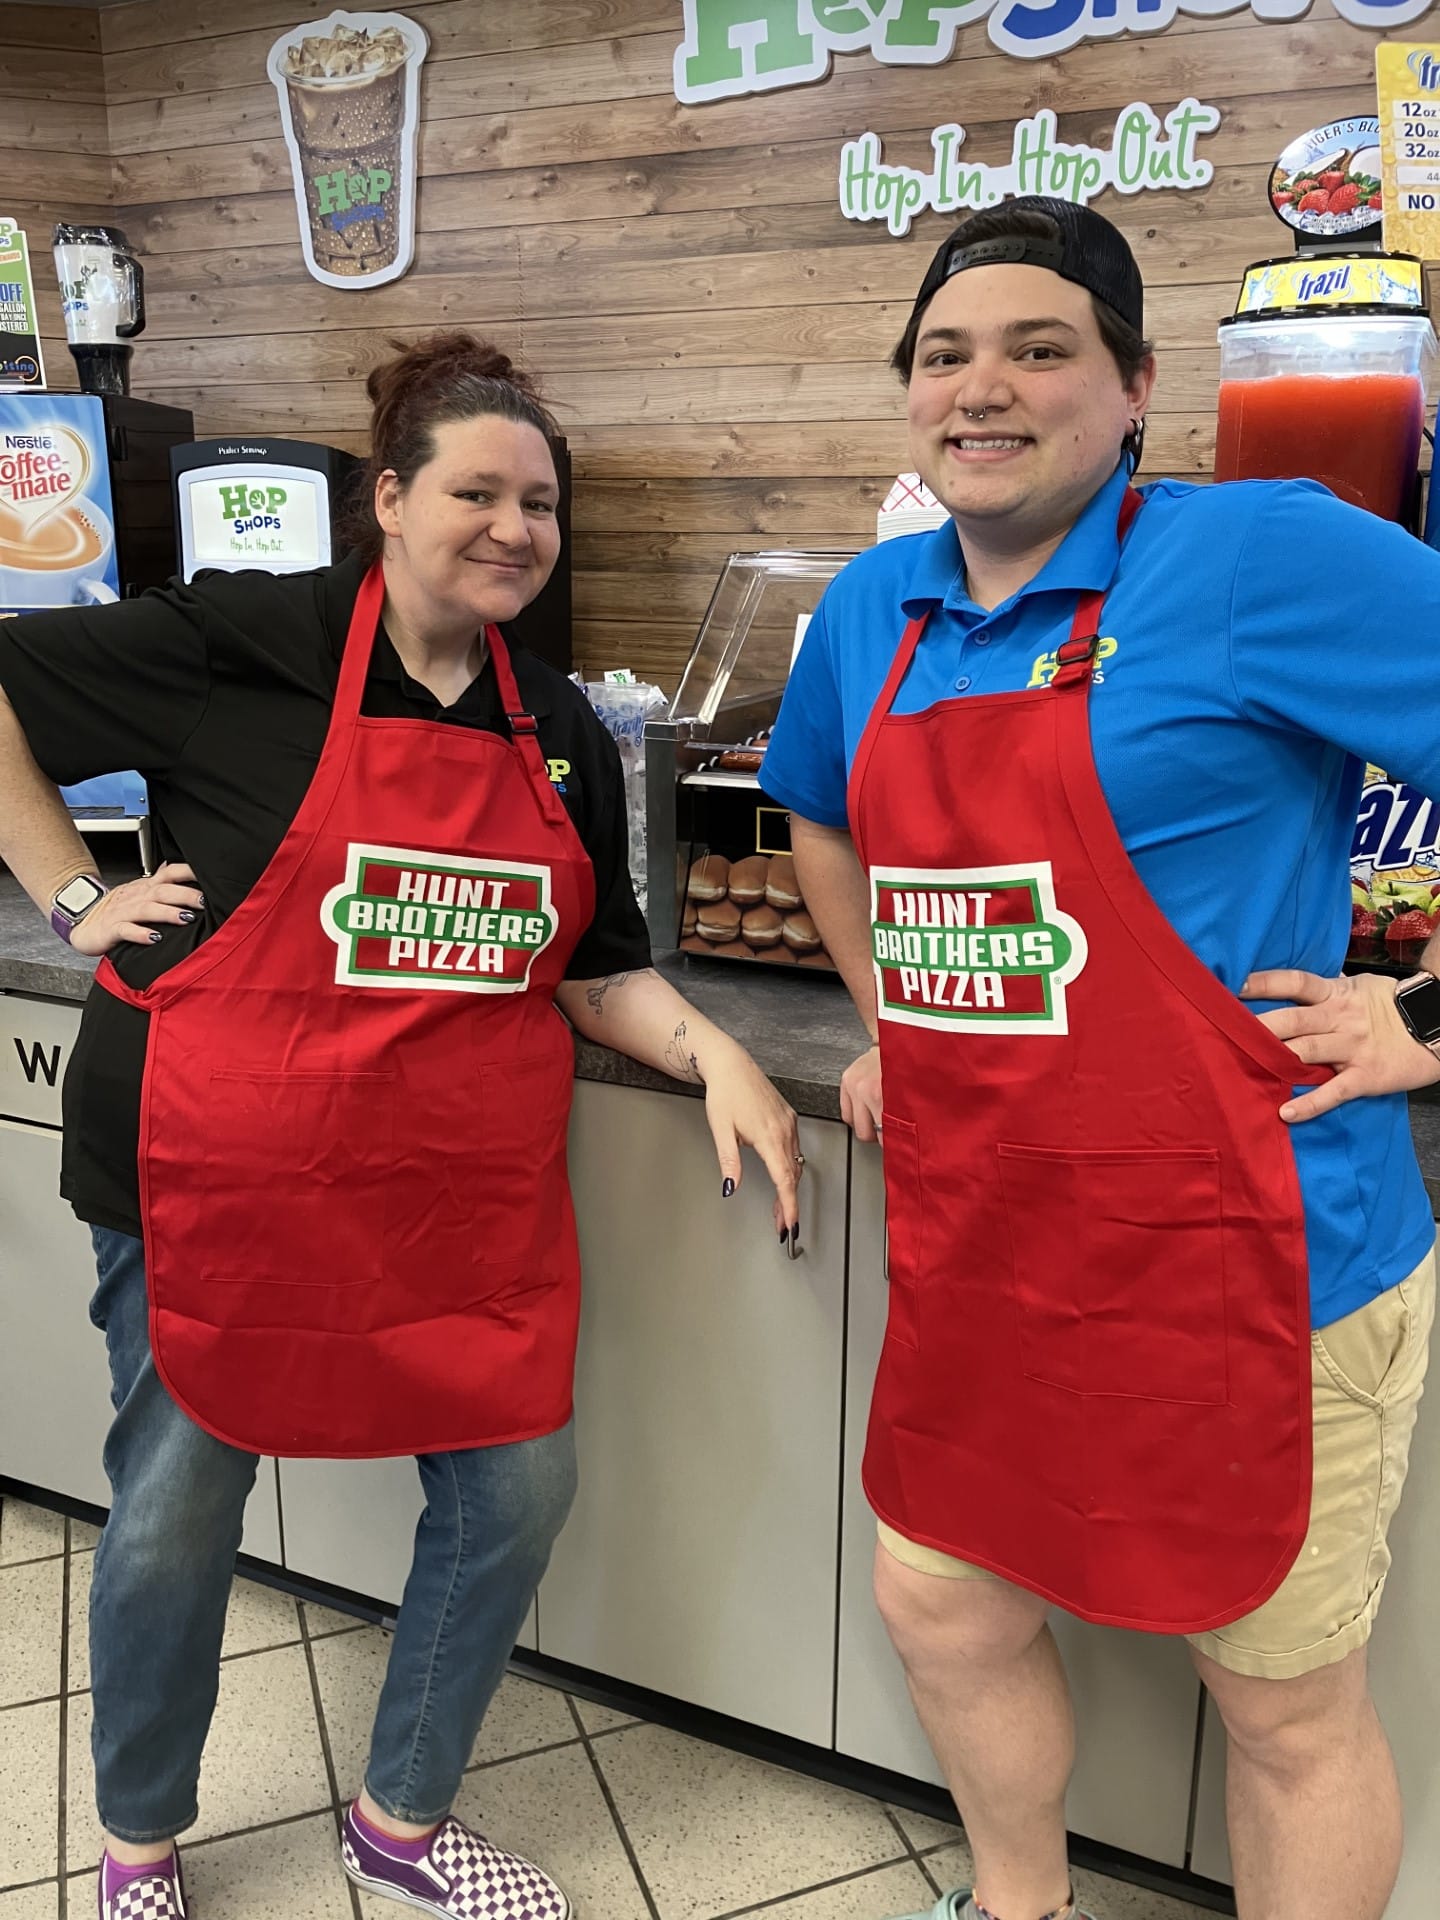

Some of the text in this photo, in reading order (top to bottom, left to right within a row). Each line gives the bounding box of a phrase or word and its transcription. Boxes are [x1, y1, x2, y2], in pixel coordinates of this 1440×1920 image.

[845, 106, 1211, 228] Hop In. Hop Out.
[314, 168, 392, 216] HOP
[1408, 194, 1435, 209] NO
[1297, 265, 1351, 300] frazil
[12, 472, 71, 500] mate
[219, 484, 287, 520] HOP
[234, 515, 281, 534] SHOPS
[397, 871, 510, 910] HUNT
[347, 900, 545, 945] BROTHERS
[892, 892, 992, 929] HUNT
[388, 935, 504, 974] PIZZA
[874, 928, 1055, 968] BROTHERS
[900, 966, 1006, 1009] PIZZA
[13, 1037, 62, 1088] W
